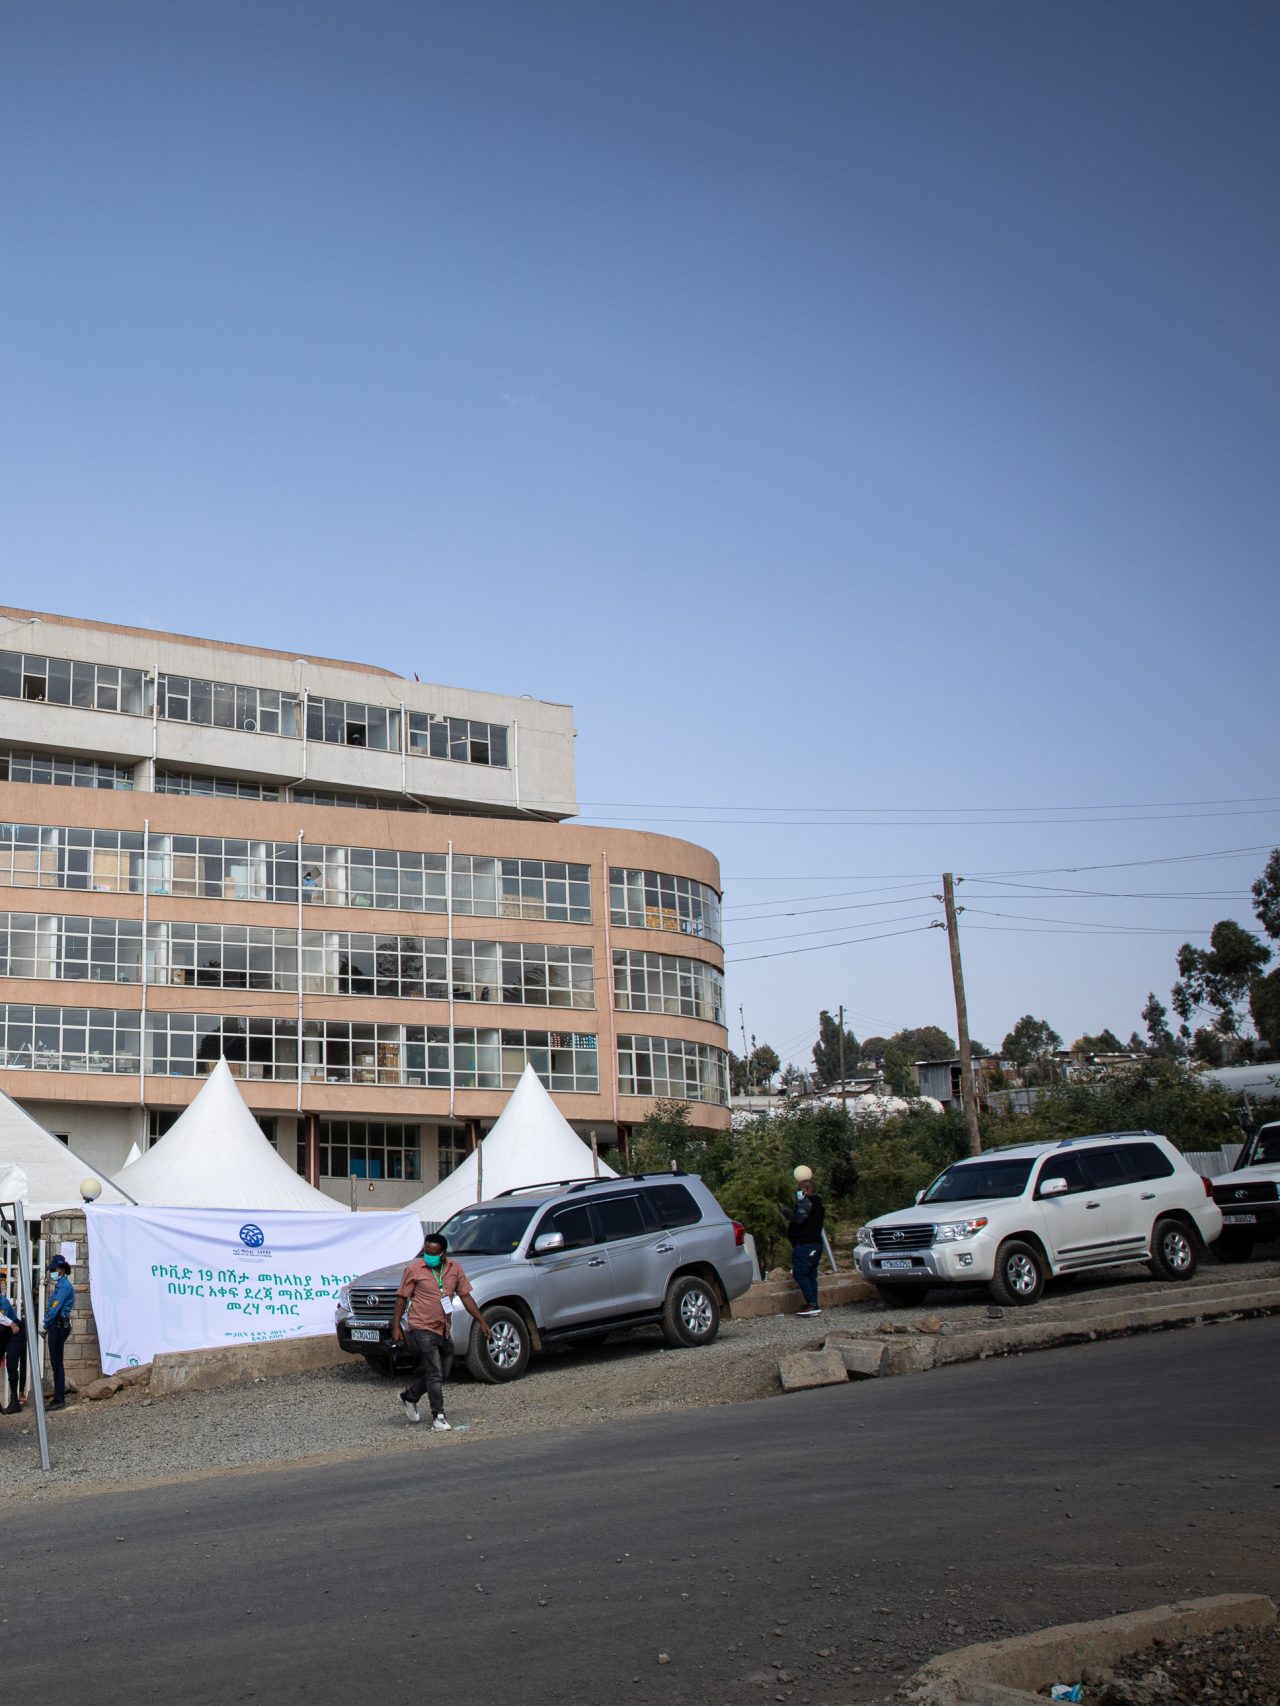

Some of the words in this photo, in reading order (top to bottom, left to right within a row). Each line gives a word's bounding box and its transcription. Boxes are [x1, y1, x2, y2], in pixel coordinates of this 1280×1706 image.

[151, 1264, 193, 1281] የኮቪድ
[197, 1268, 213, 1282] 19
[217, 1268, 250, 1285] በሽታ
[257, 1273, 313, 1287] መከላከያ
[167, 1282, 205, 1298] በሀገር
[208, 1285, 240, 1299] አቀፍ
[244, 1287, 273, 1302] ደረጃ
[265, 1303, 300, 1317] ግብር
